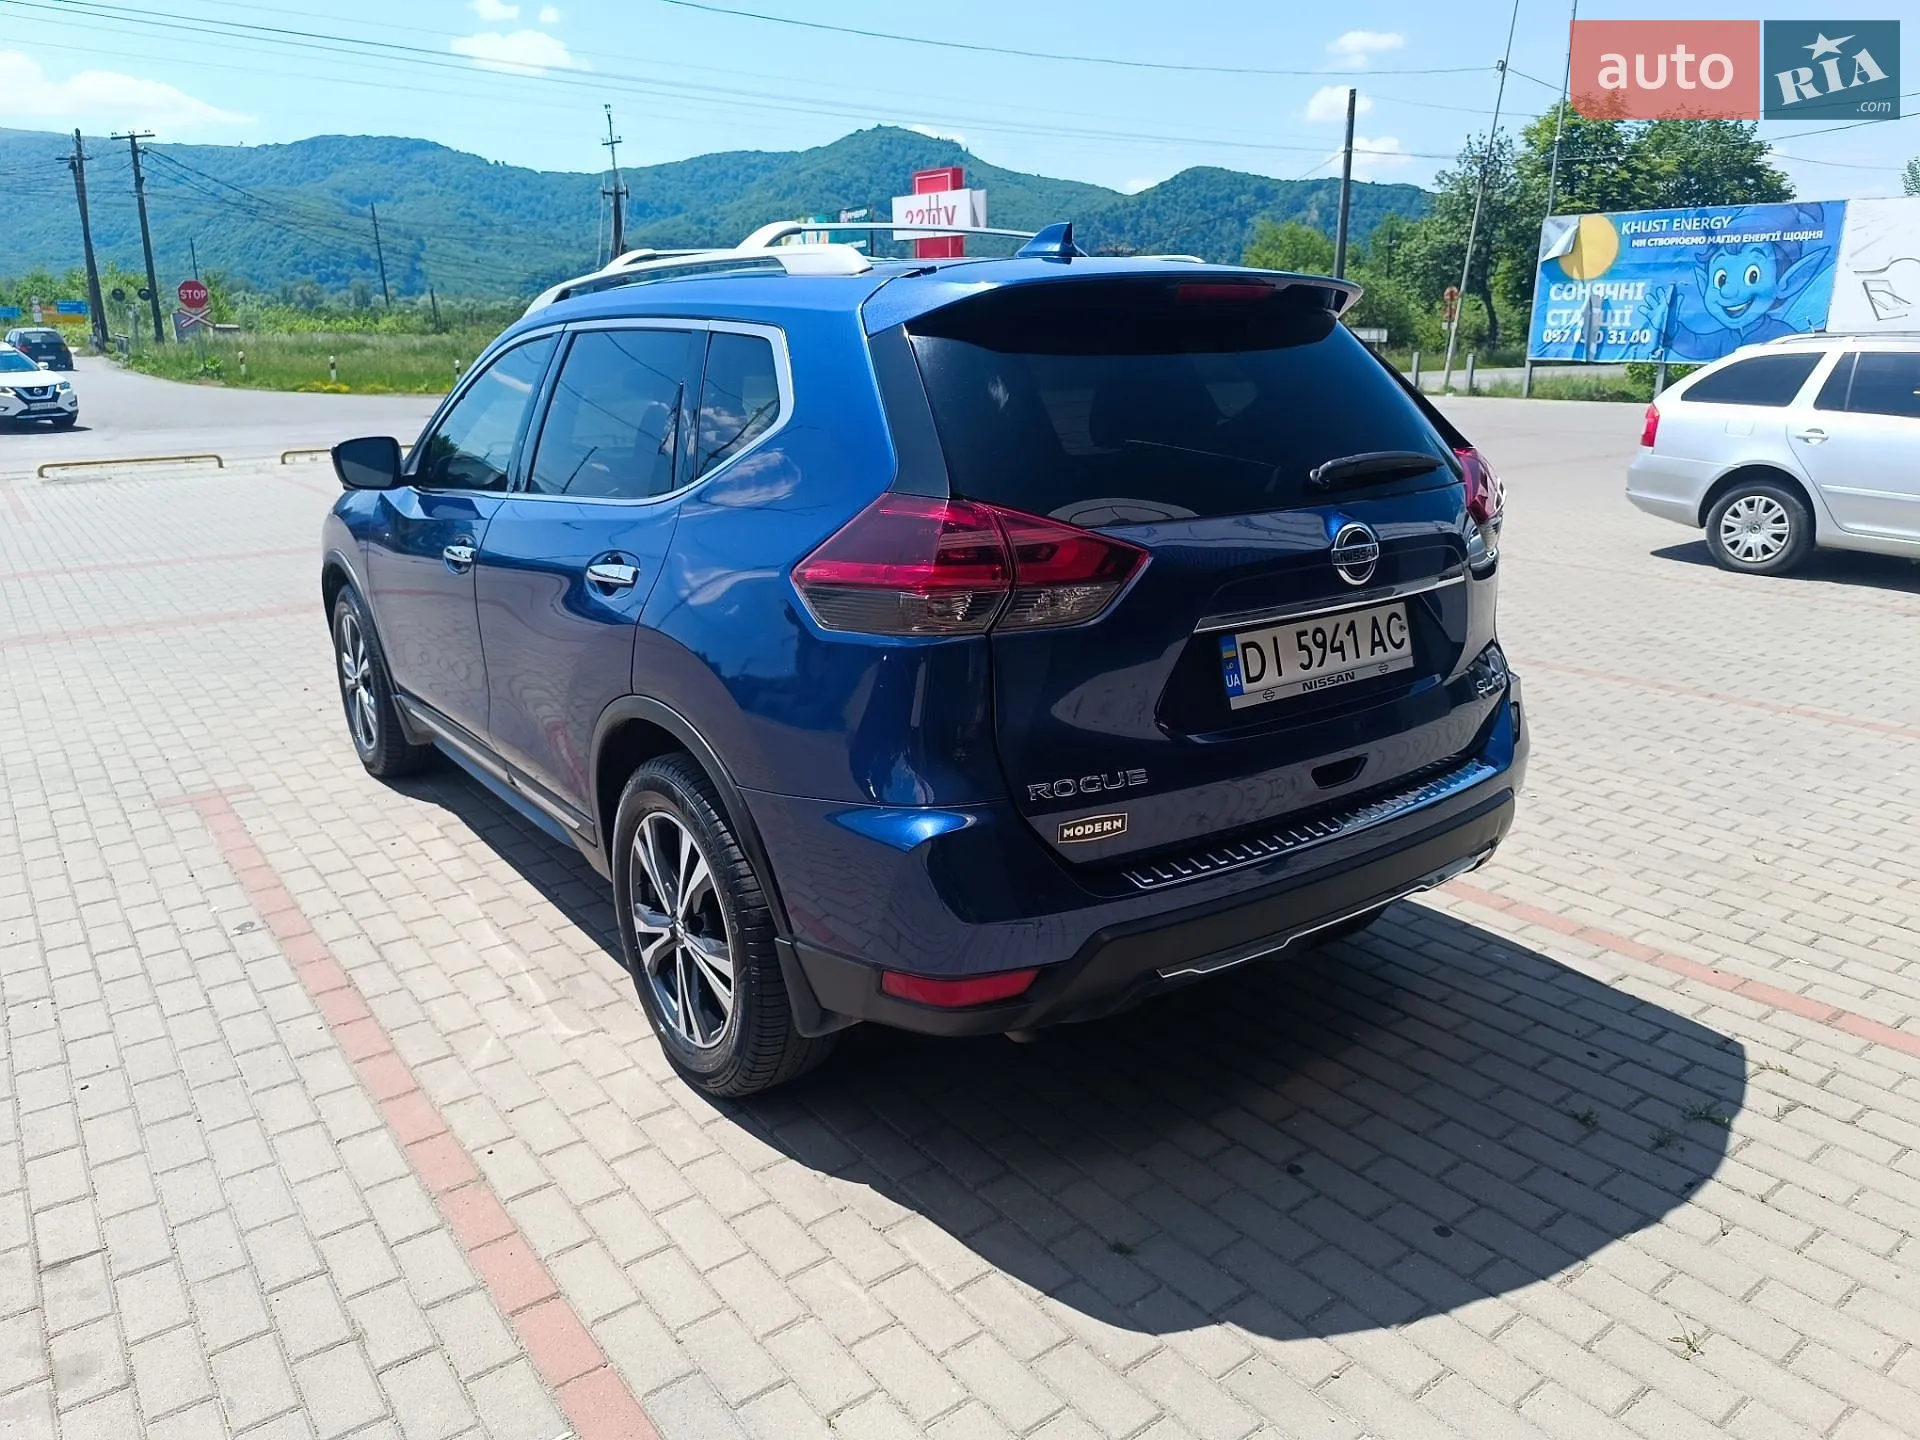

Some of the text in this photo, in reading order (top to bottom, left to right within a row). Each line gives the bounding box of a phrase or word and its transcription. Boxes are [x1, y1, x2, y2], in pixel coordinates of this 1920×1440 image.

[1621, 215, 1732, 235] KHUST ENERGY
[1783, 229, 1824, 242] ЩОДНЯ
[180, 289, 207, 300] STOP
[1607, 328, 1627, 345] 31
[1240, 611, 1406, 684] DI 5941 AC
[1226, 673, 1241, 688] UA
[1302, 671, 1356, 692] NISSAN
[1027, 768, 1149, 801] ROGUE
[1063, 819, 1123, 838] MODERN
